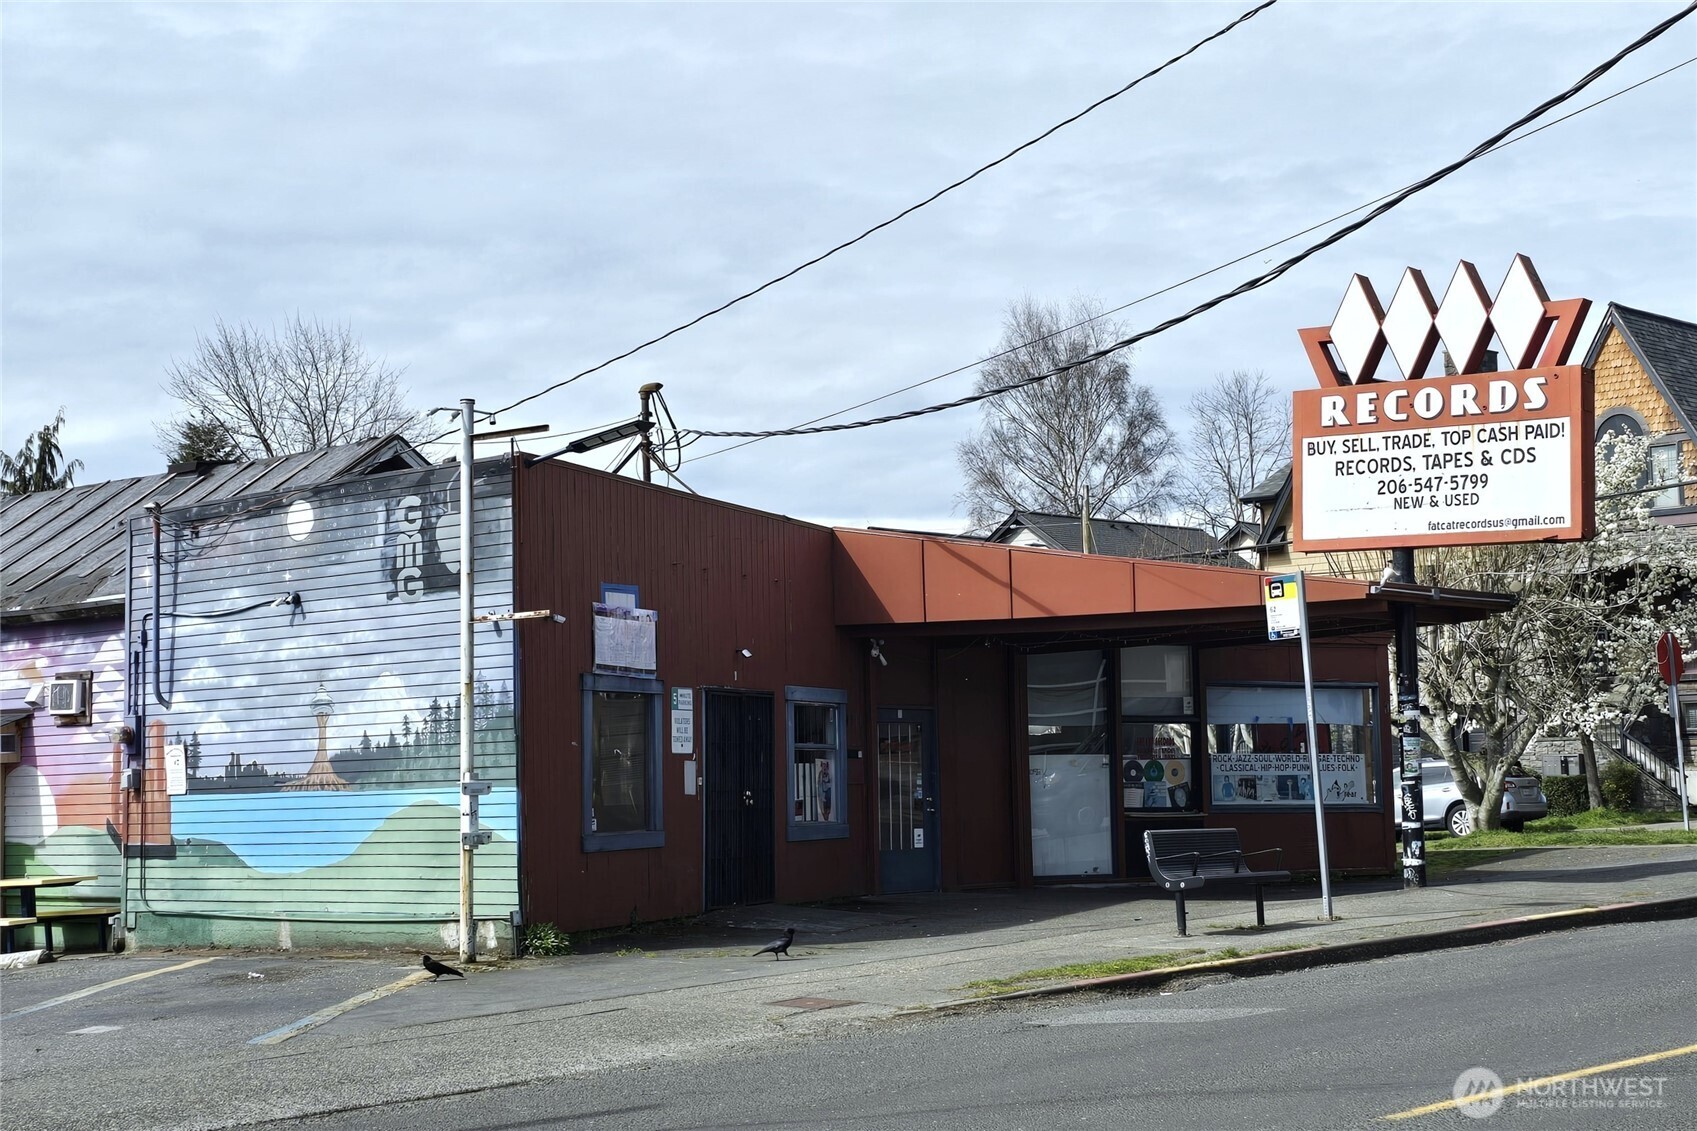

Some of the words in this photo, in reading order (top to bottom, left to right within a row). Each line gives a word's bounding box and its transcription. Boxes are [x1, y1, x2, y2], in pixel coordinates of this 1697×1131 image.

[1321, 376, 1549, 428] RECORDS
[1307, 440, 1337, 456] BUY,
[1342, 437, 1379, 454] SELL,
[1382, 433, 1435, 451] TRADE,
[1441, 430, 1471, 446] TOP
[1477, 425, 1519, 443] CASH
[1525, 422, 1565, 440] PAID!
[1335, 456, 1416, 476] RECORDS,
[1422, 451, 1474, 471] TAPES
[1480, 450, 1493, 466] &
[1501, 447, 1536, 465] CDS
[1377, 473, 1489, 495] 206-547-5799
[1394, 496, 1424, 510] NEW
[1429, 495, 1439, 508] &
[1445, 493, 1480, 507] USED
[1428, 515, 1565, 531] fatcatrecordsus@gmail.com
